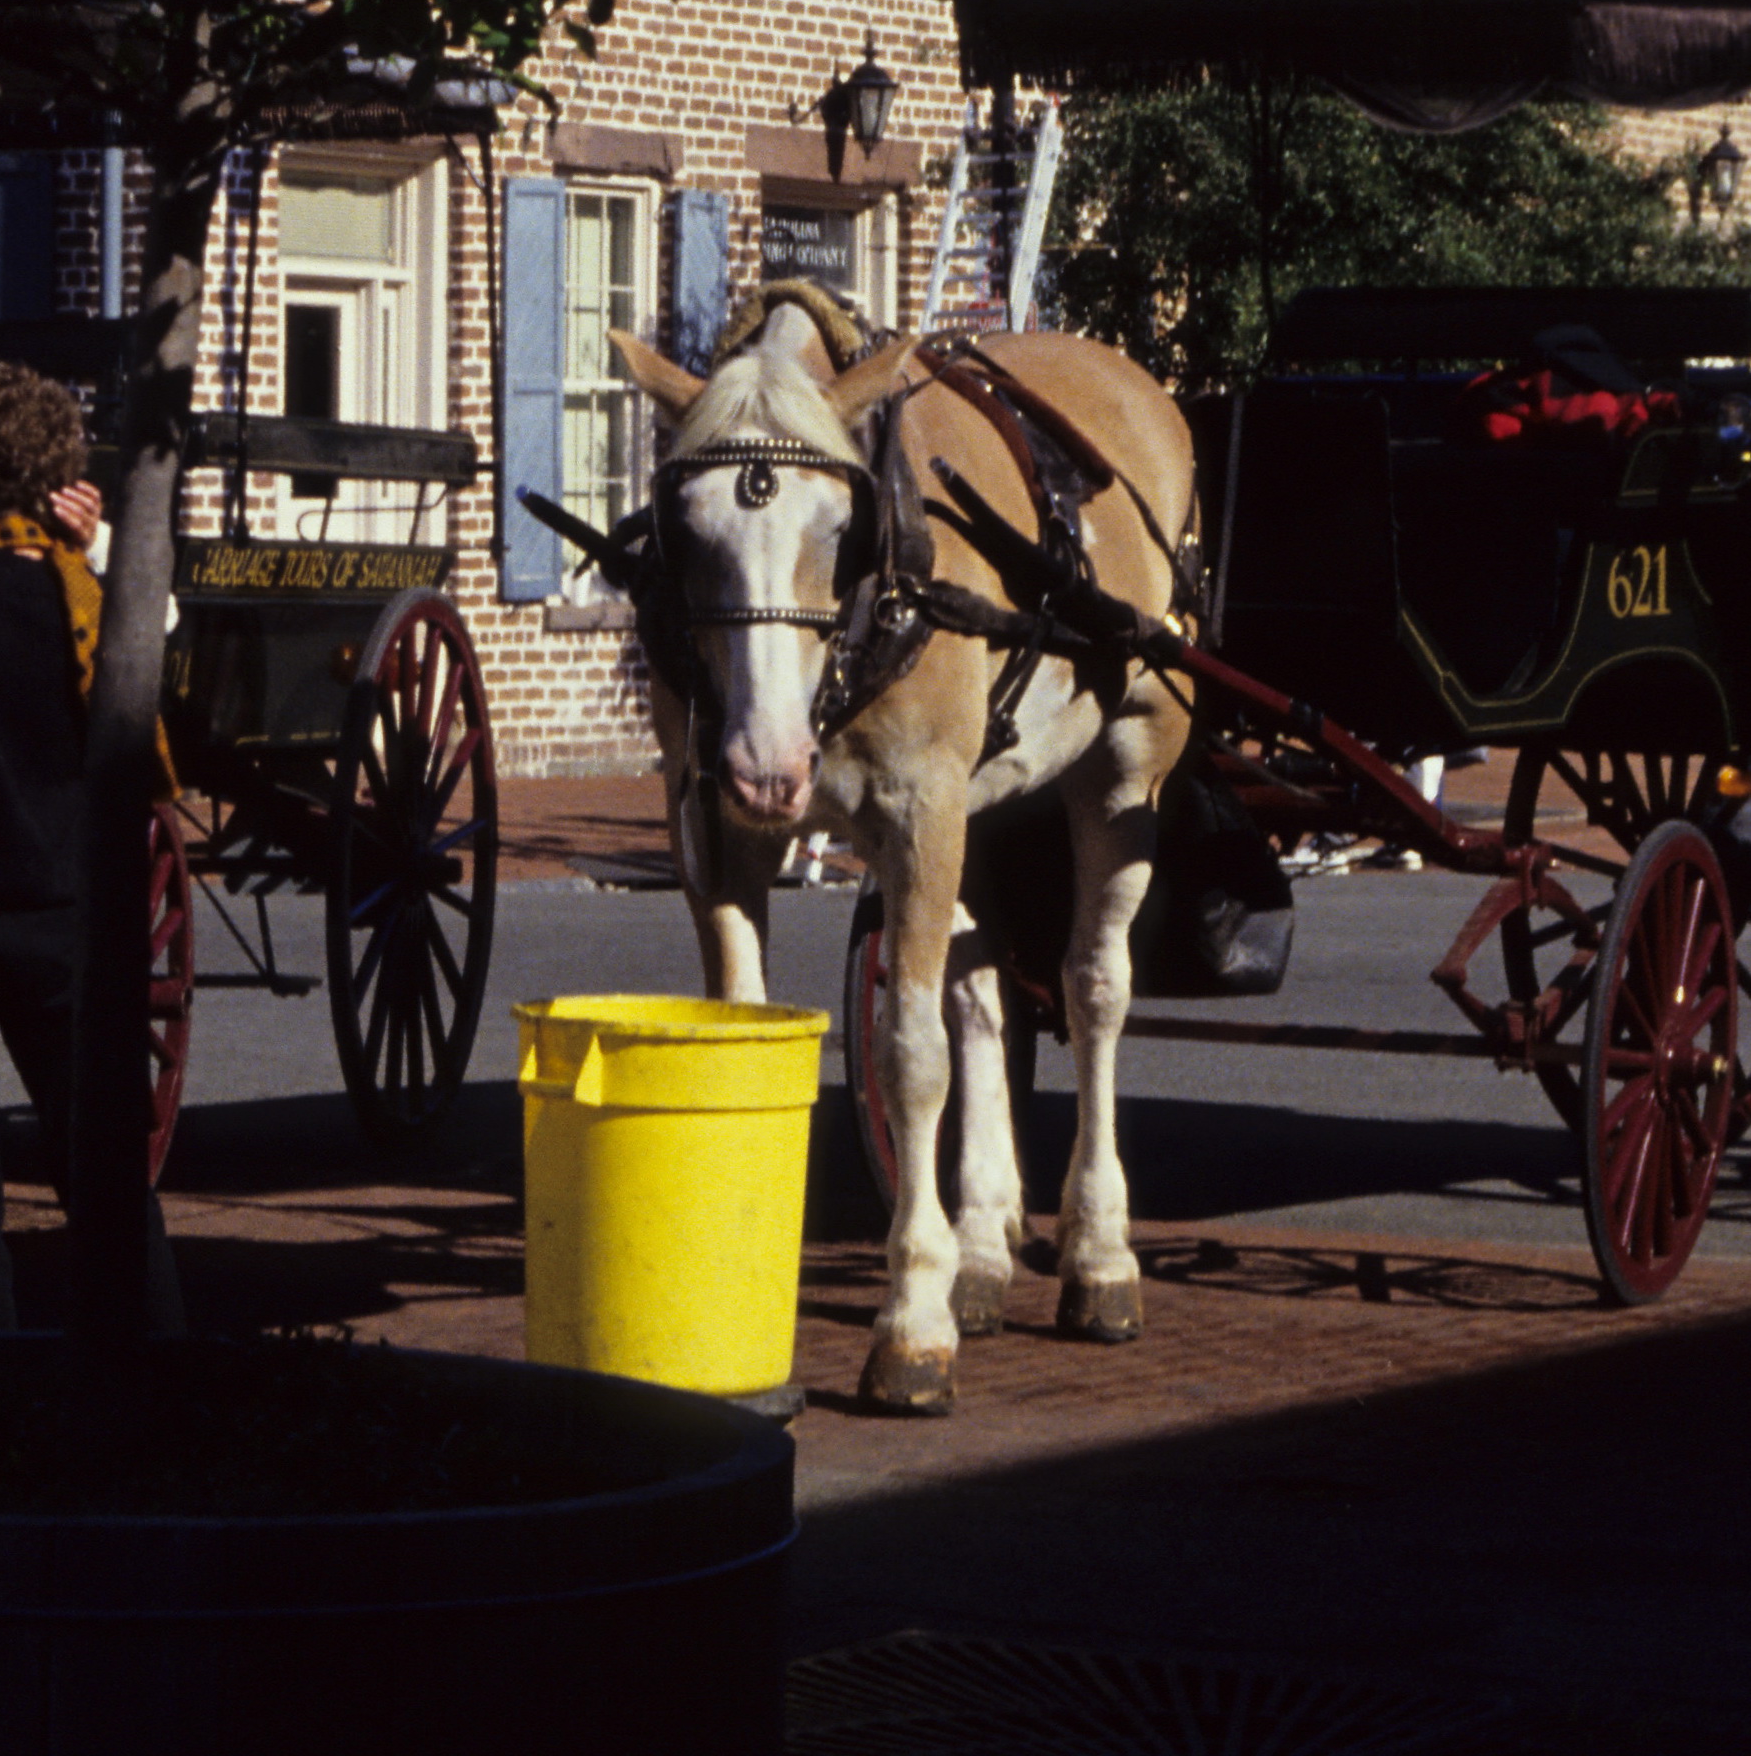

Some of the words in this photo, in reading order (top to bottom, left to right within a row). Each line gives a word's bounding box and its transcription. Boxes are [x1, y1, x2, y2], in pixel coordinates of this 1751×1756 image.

[279, 548, 333, 589] TOURS
[332, 551, 360, 589] OF
[357, 552, 442, 590] SAVANNAH
[1607, 544, 1672, 619] 621
